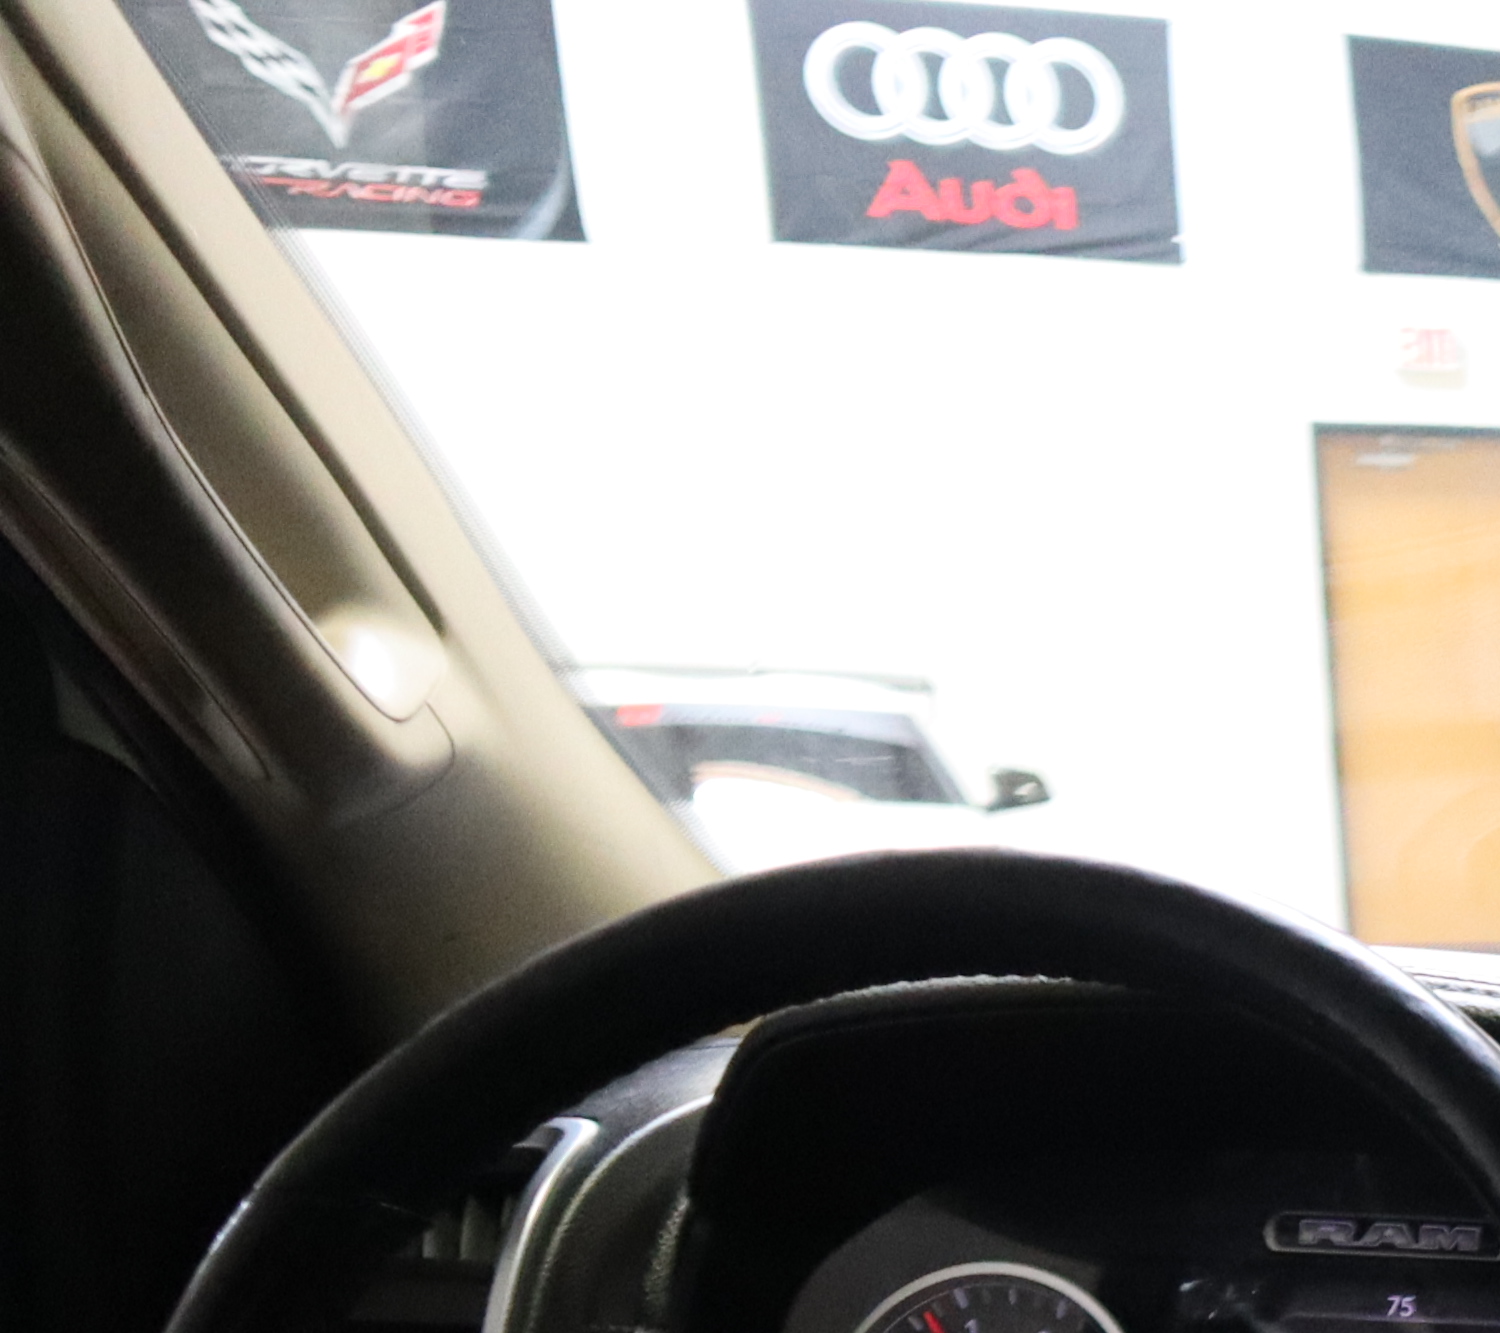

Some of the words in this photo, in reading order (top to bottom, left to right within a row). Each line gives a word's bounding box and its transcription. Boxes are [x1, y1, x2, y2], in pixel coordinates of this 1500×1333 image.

[866, 159, 1079, 231] Audi
[1298, 1218, 1482, 1250] RAM
[1386, 1294, 1417, 1318] 75
